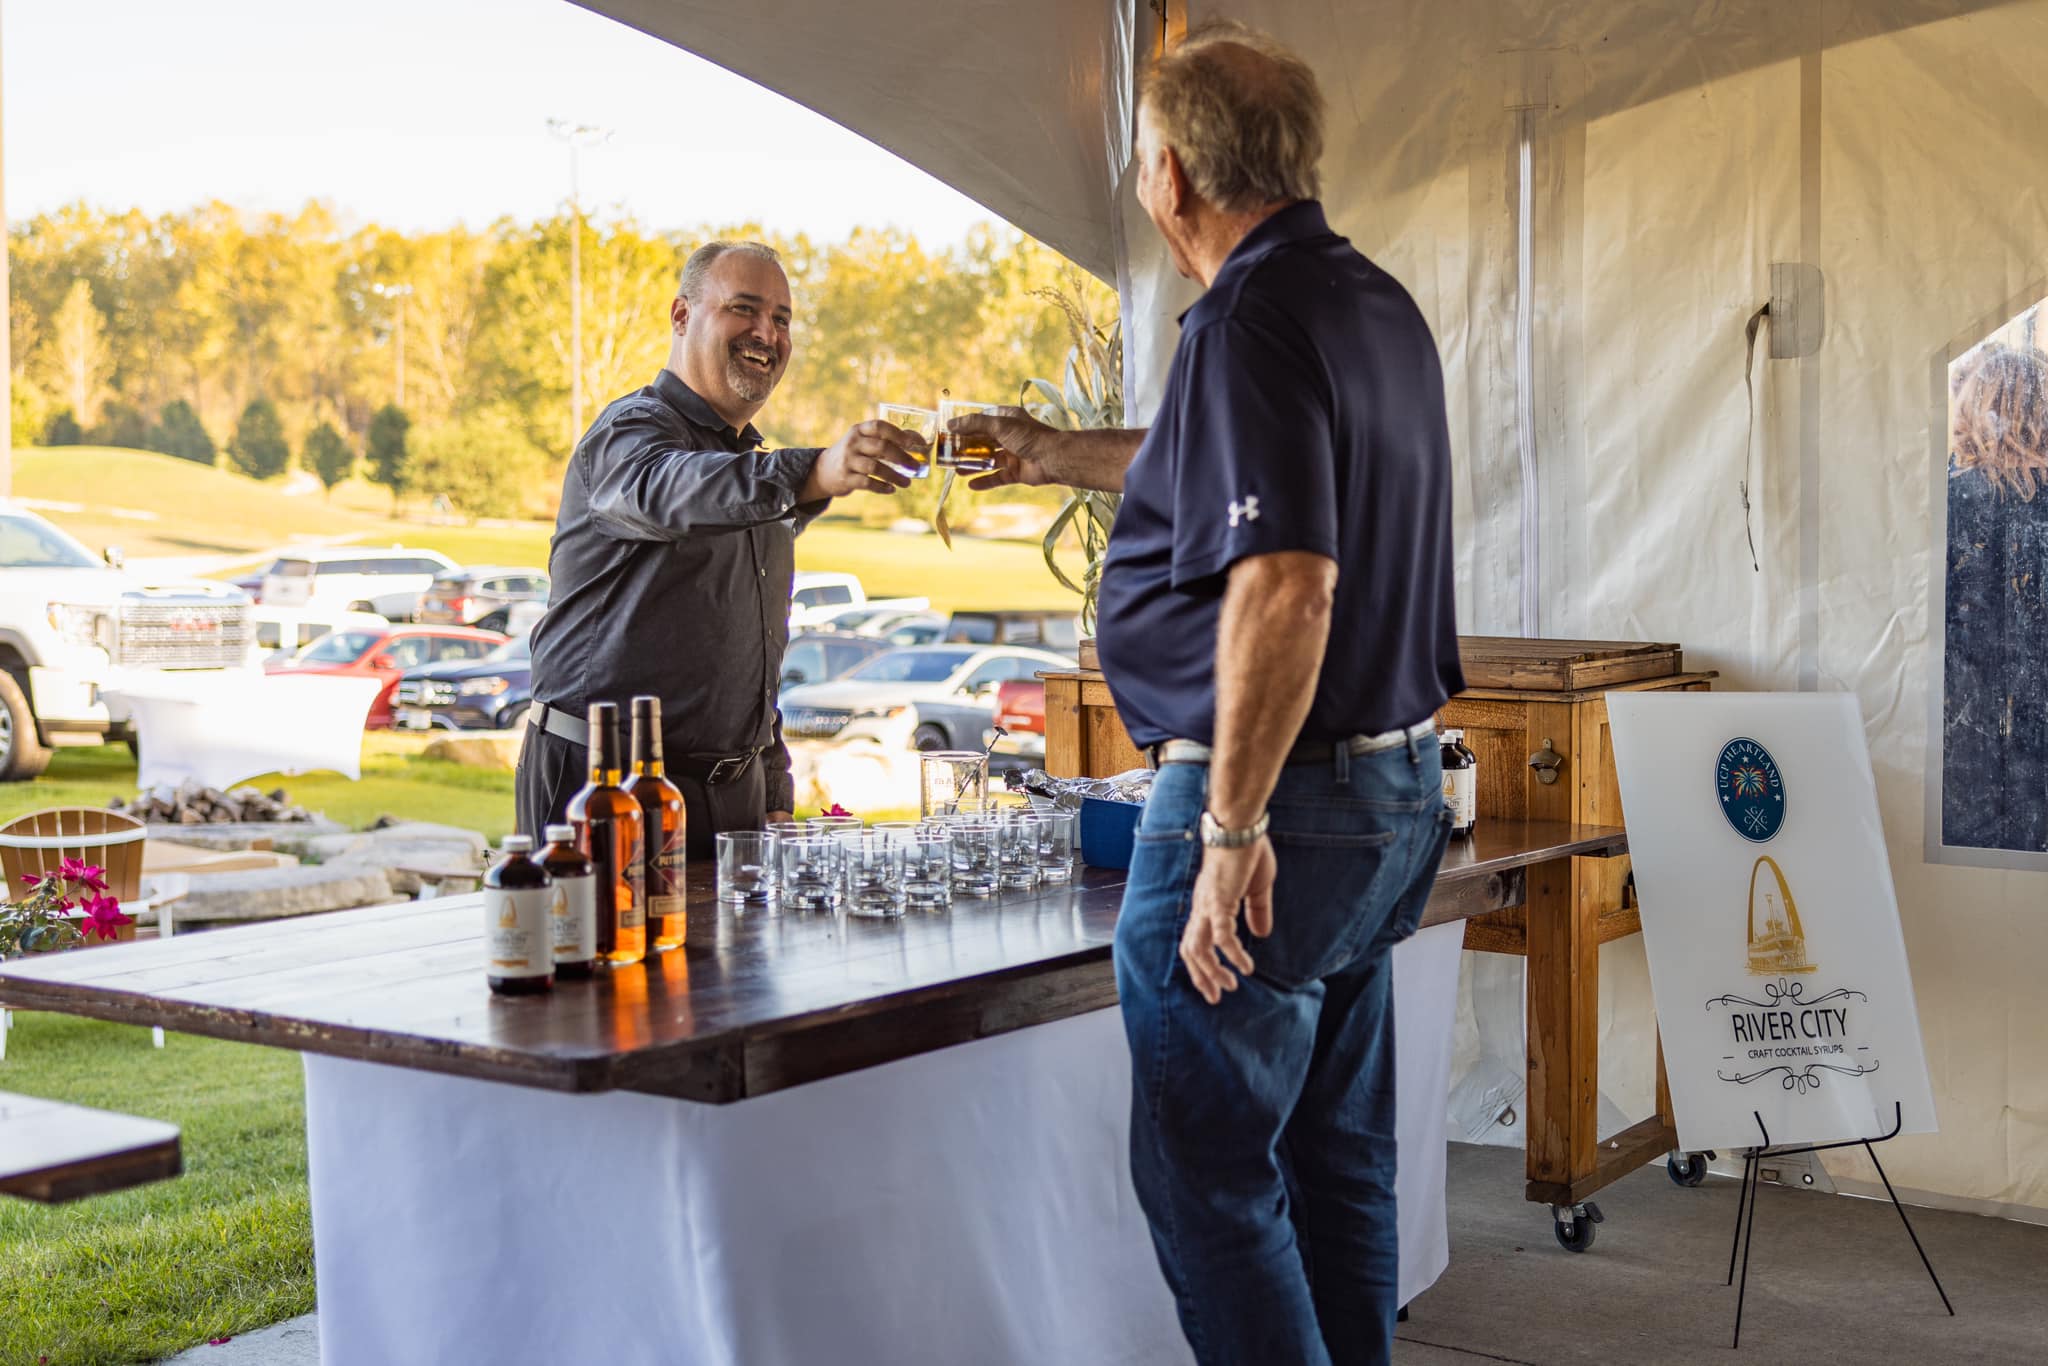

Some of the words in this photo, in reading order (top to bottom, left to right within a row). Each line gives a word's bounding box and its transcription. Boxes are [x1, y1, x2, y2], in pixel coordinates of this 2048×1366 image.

[1719, 763, 1730, 788] UCP
[1724, 743, 1780, 788] HEARTLAND
[1732, 1011, 1797, 1043] RIVER
[1800, 1008, 1847, 1039] CITY
[1748, 1048, 1773, 1059] CRAFT
[1774, 1045, 1813, 1057] COCKTAIL
[1814, 1044, 1844, 1055] SYRUPS
